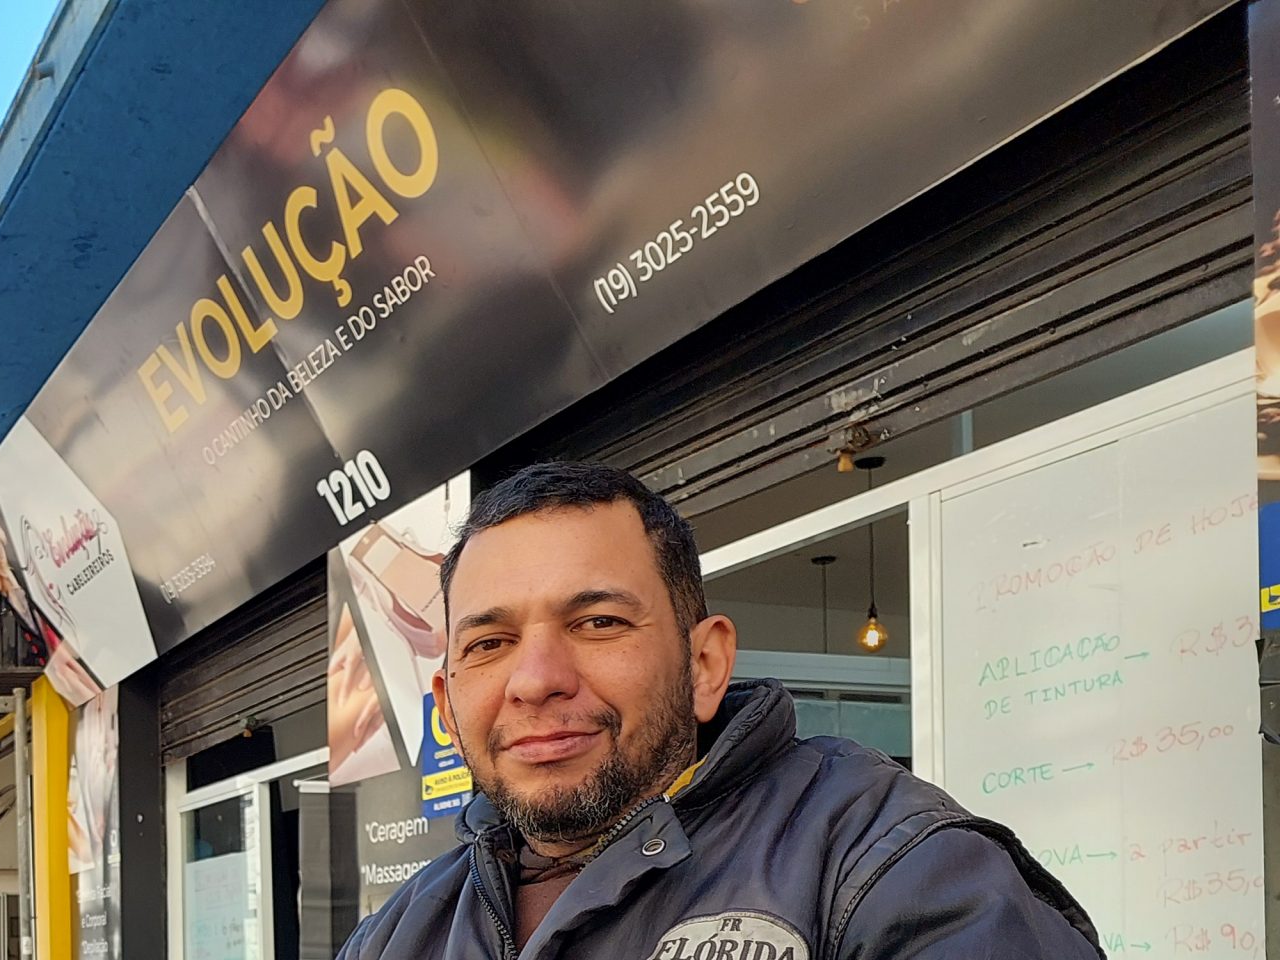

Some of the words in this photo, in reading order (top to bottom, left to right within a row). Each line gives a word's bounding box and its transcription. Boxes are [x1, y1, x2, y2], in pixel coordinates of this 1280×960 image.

[137, 88, 439, 433] EVOLUÇÃO
[593, 262, 638, 314] (19)
[629, 172, 761, 282] 3025-2559
[213, 397, 271, 458] CANTINHO
[266, 382, 293, 411] DA
[286, 339, 343, 396] BELEZA
[335, 326, 353, 351] E
[347, 306, 376, 341] DO
[373, 255, 437, 319] SABOR
[316, 449, 391, 526] 1210
[984, 696, 1012, 721] DE
[1024, 670, 1124, 705] TINTURA
[982, 763, 1055, 795] CORTE
[720, 918, 743, 933] FR
[1103, 934, 1126, 951] VA
